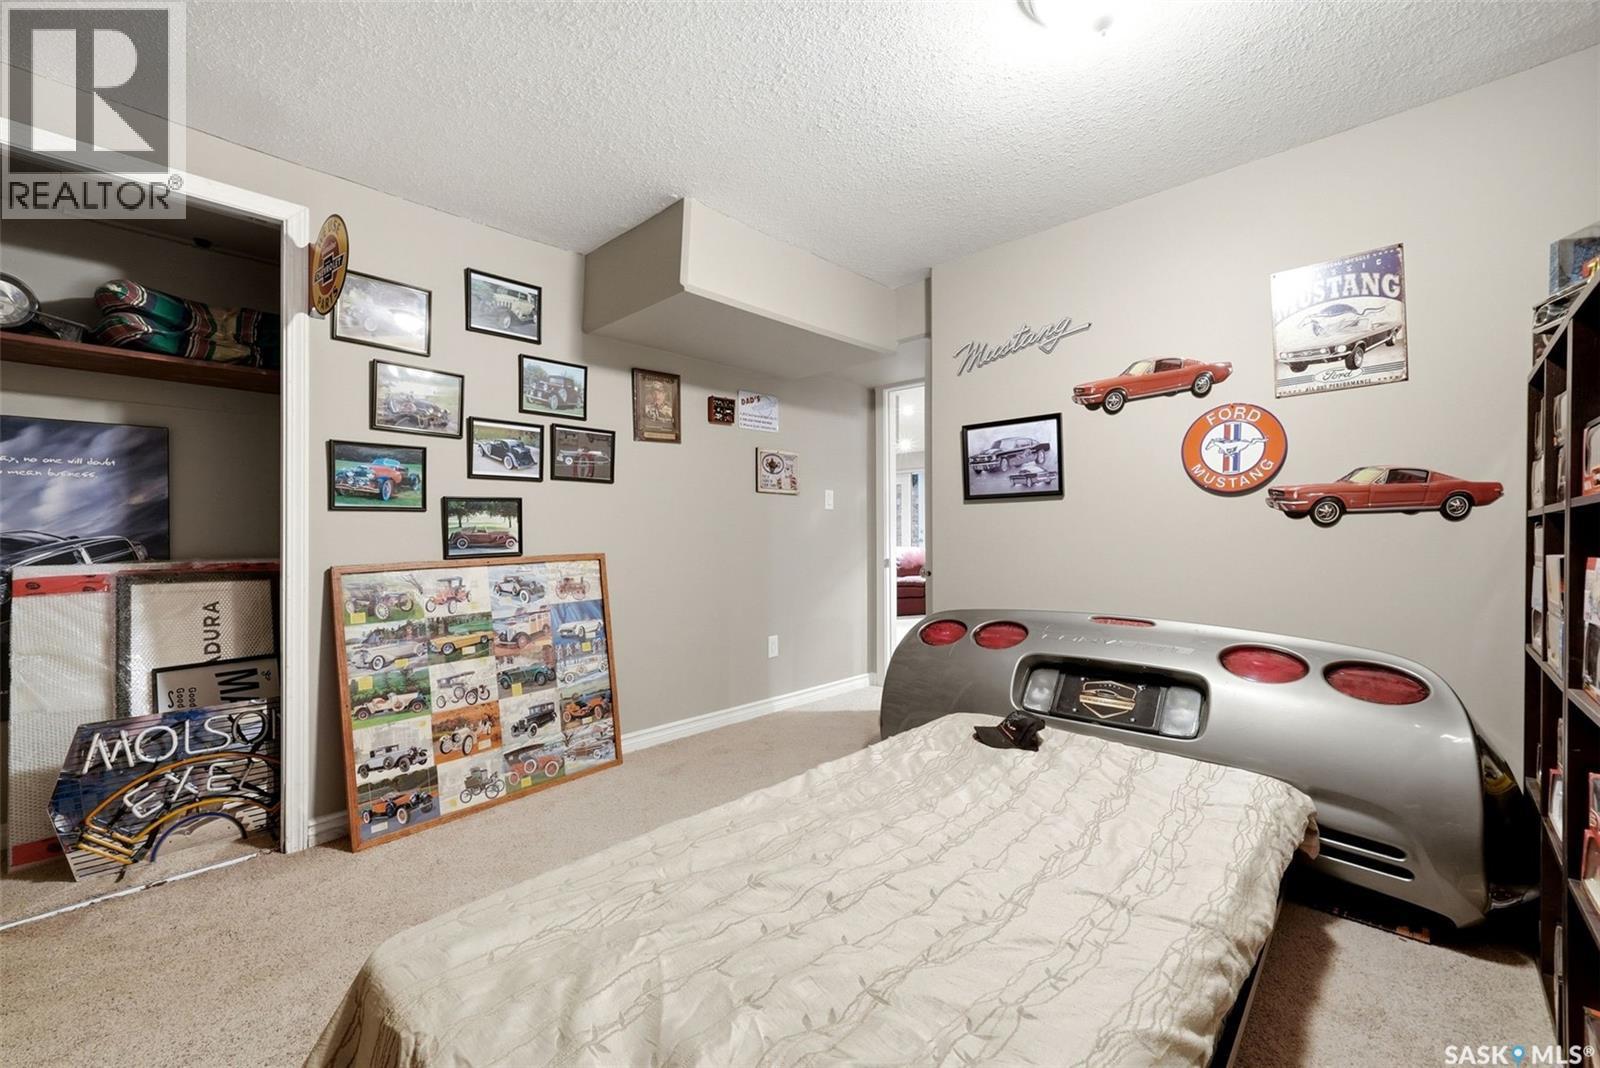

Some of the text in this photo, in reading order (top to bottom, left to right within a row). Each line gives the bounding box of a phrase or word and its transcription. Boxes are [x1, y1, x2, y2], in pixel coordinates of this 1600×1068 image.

[952, 317, 1093, 377] Mustang
[1322, 368, 1353, 381] Ford
[1205, 405, 1262, 427] FORD
[0, 455, 19, 464] ay,
[86, 458, 116, 467] doubt
[7, 469, 43, 477] mean
[1190, 457, 1276, 489] MUSTANG
